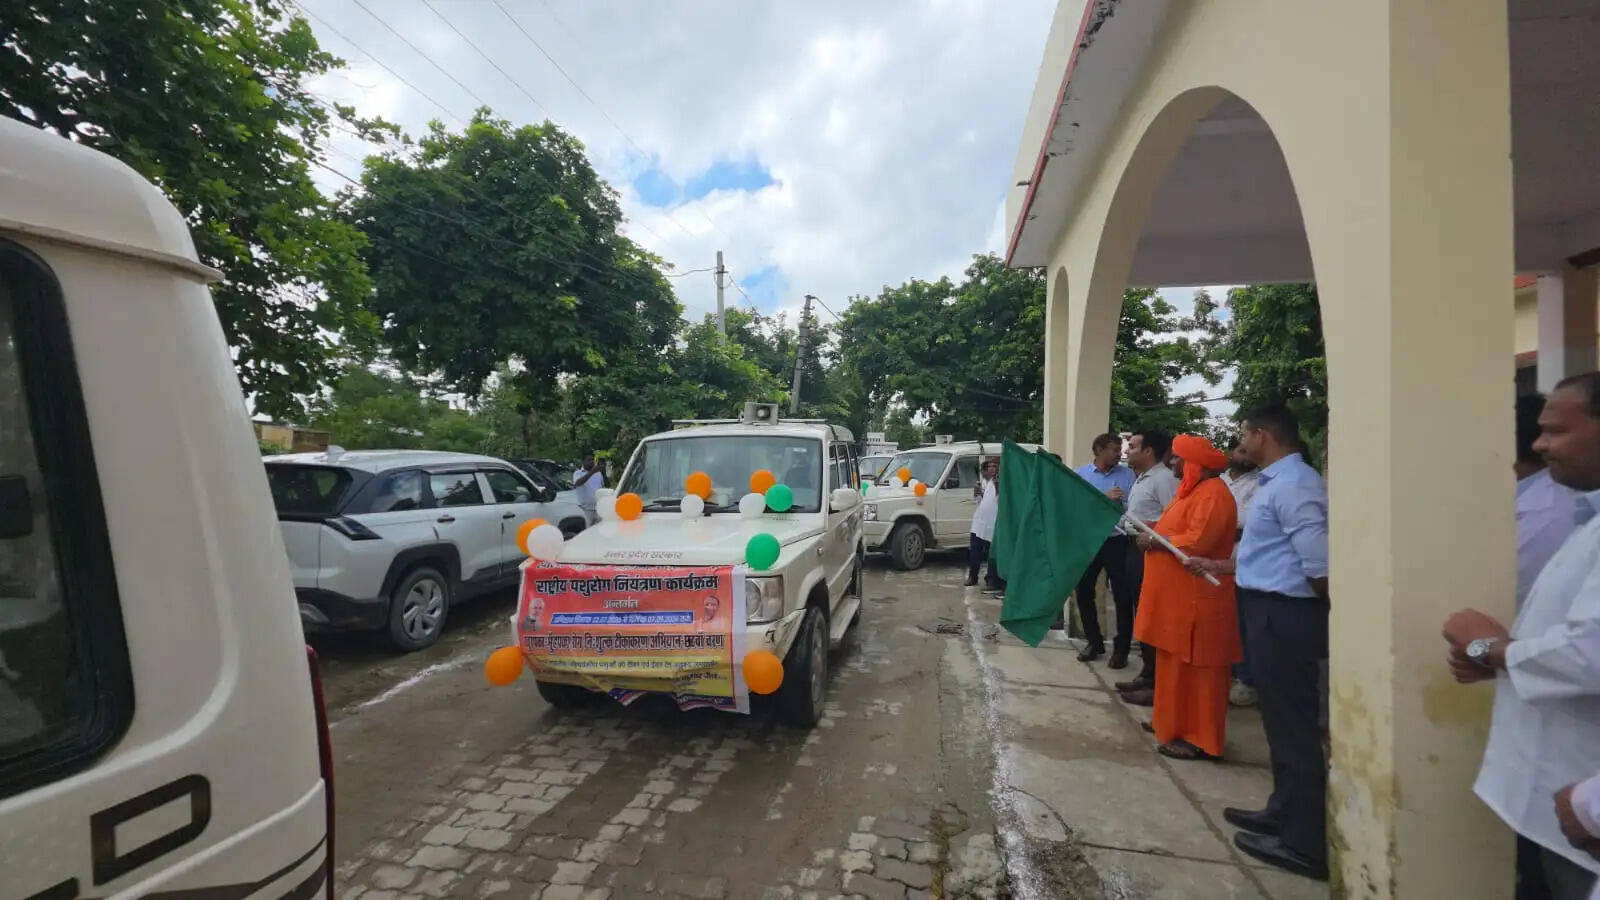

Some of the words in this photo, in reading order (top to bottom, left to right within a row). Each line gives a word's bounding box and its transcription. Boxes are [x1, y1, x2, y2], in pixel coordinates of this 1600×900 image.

[536, 576, 567, 595] राष्ट्रीय
[570, 575, 611, 597] पशुरोग
[613, 575, 662, 592] नियंत्रण
[665, 573, 719, 590] कार्यक्रम
